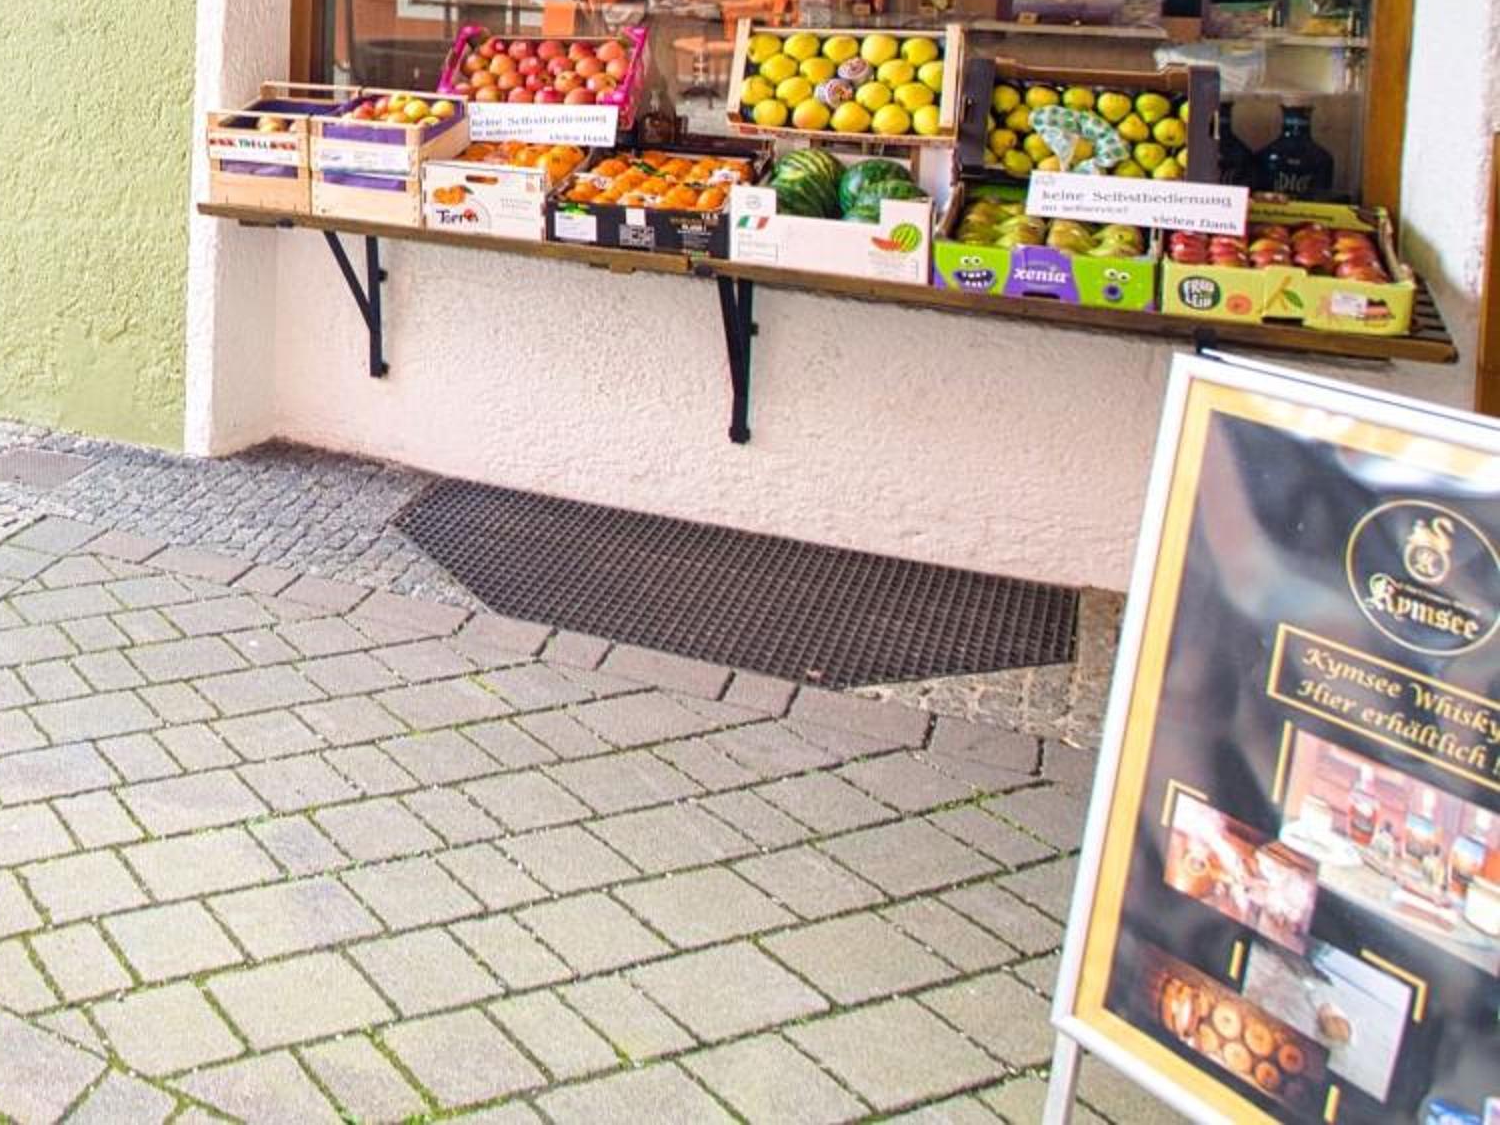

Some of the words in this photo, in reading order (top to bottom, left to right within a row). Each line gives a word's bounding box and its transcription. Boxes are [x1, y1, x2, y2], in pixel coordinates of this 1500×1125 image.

[1041, 189, 1085, 202] keine
[1092, 190, 1234, 209] Selbstbedienung
[1152, 214, 1196, 227] vielen
[1199, 217, 1238, 231] Dank
[1013, 265, 1070, 284] xenia
[1301, 647, 1404, 699] Kymsee
[1409, 681, 1500, 744] Whisky
[1296, 679, 1358, 715] Hier
[1360, 706, 1488, 770] erhältlich
